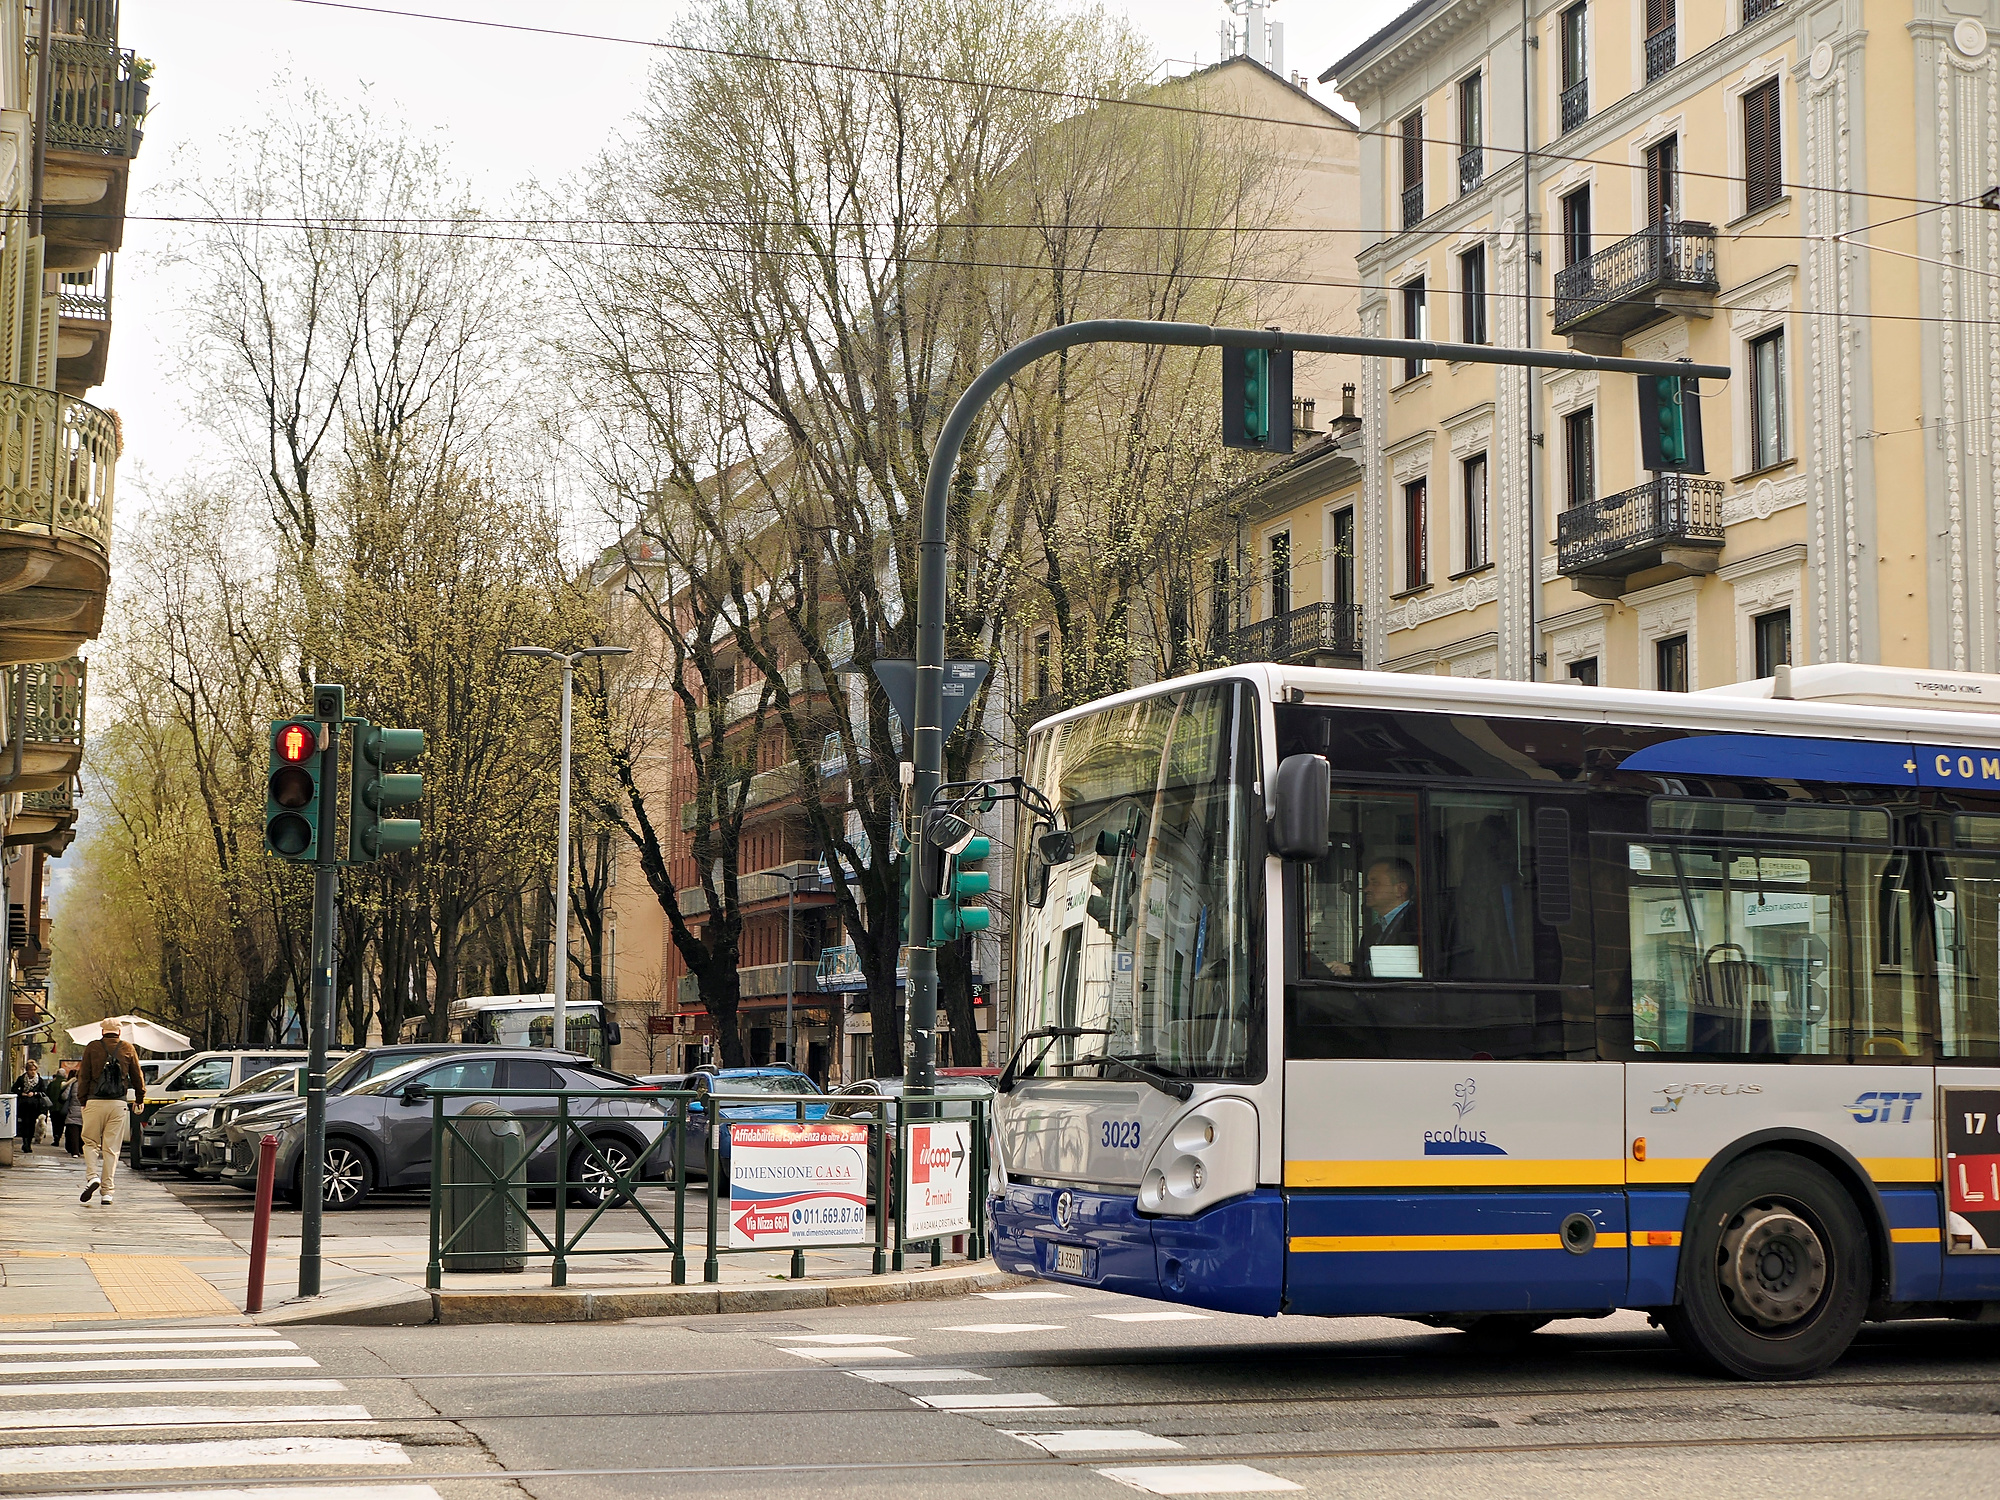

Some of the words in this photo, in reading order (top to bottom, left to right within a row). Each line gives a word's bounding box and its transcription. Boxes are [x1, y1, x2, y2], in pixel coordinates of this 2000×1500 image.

[1915, 682, 1957, 692] THERMO
[1960, 685, 1982, 694] KING
[1780, 901, 1809, 911] AGRICOLE
[1850, 1091, 1923, 1124] GTT
[1963, 1112, 1987, 1135] 17
[734, 1128, 775, 1142] Affidabilità
[820, 1133, 828, 1142] da
[828, 1133, 840, 1142] oltre
[840, 1132, 849, 1142] 25
[849, 1131, 865, 1142] anni
[1101, 1120, 1141, 1149] 3023
[735, 1166, 813, 1179] DIMENSIONE
[815, 1165, 852, 1178] CASA
[925, 1187, 931, 1206] 2
[931, 1189, 952, 1206] minuti
[746, 1216, 756, 1230] Via
[757, 1216, 774, 1230] Nizza
[774, 1215, 788, 1231] 66/A
[803, 1206, 865, 1225] 011.669.87.60
[792, 1226, 864, 1237] www.dimensionecasatorino.it
[912, 1222, 920, 1231] VIA
